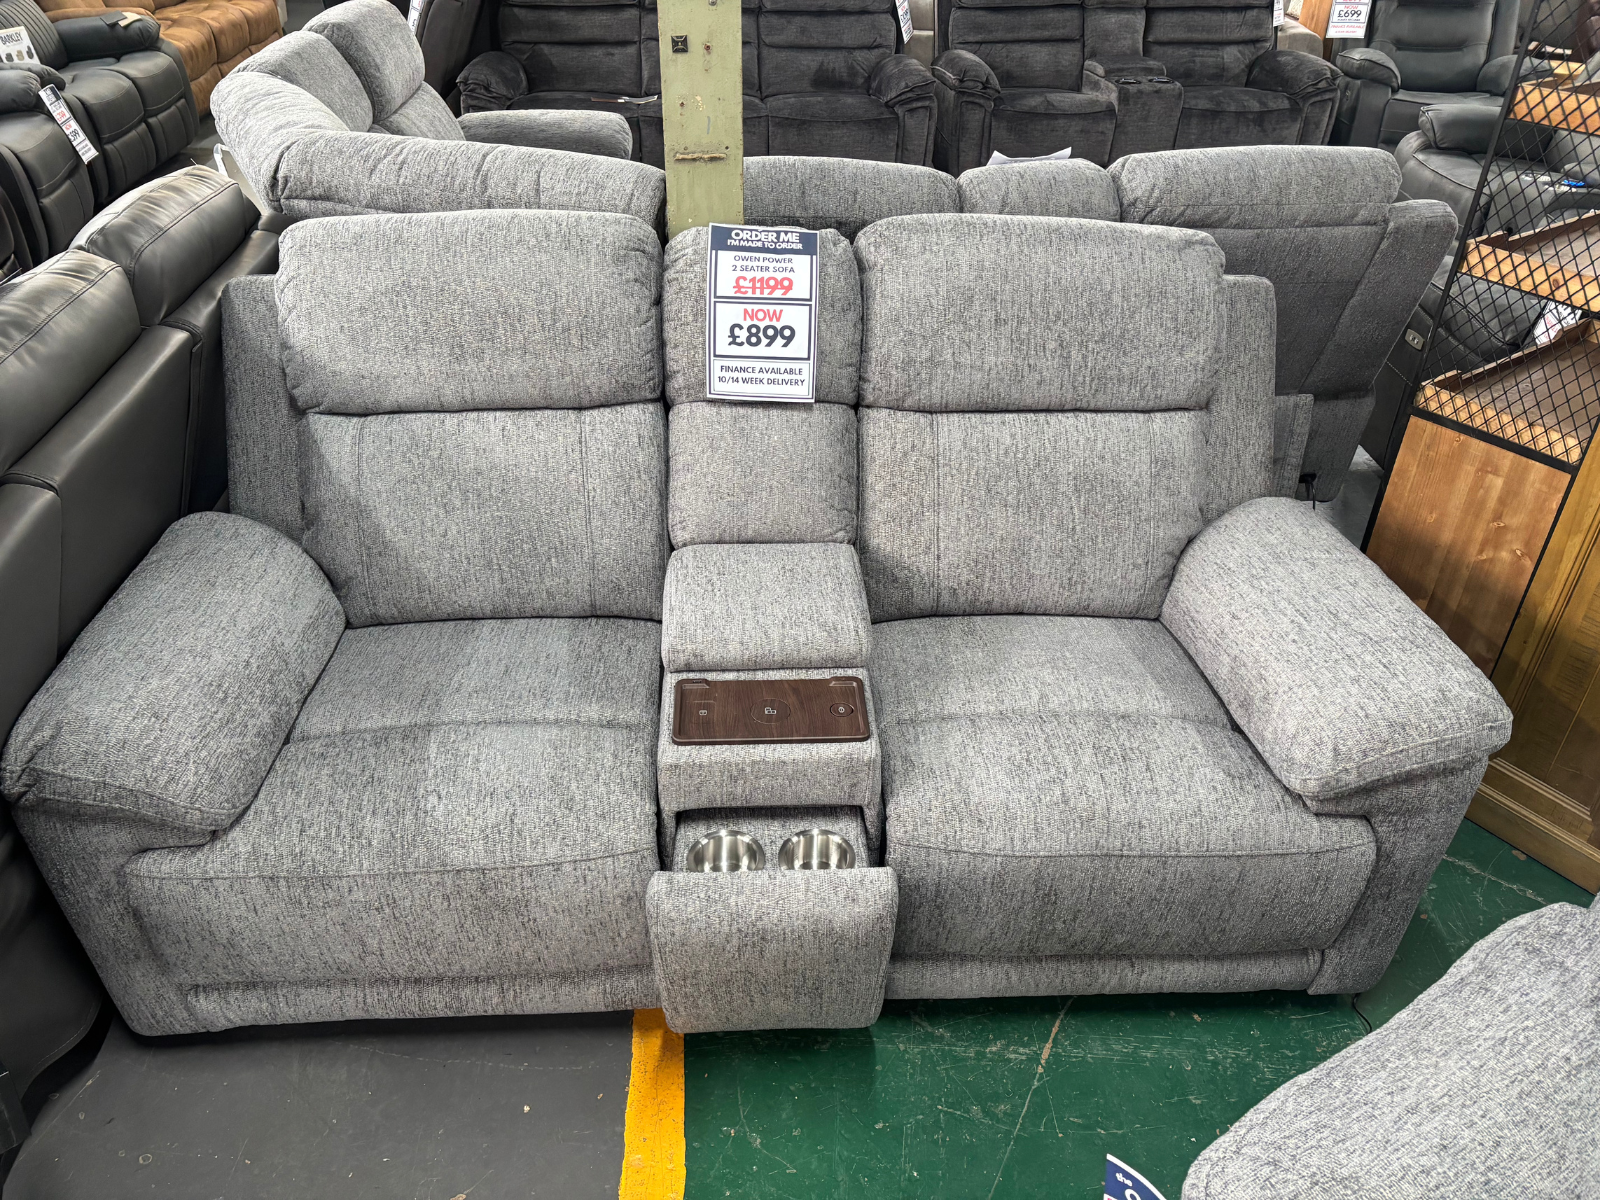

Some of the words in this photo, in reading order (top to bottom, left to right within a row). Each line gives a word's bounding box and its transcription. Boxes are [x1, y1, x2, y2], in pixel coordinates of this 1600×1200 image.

[1337, 9, 1362, 18] £699
[731, 230, 777, 242] ORDER
[780, 232, 800, 243] ME
[762, 256, 793, 264] POWER
[732, 264, 738, 272] 2
[740, 265, 770, 273] SEATER
[733, 275, 794, 296] £1199
[743, 308, 783, 322] NOW
[727, 323, 796, 348] £899
[720, 365, 756, 374] FINANCE
[758, 366, 803, 375] AVAILABLE
[717, 376, 739, 384] 10/14
[741, 376, 765, 385] WEEK
[766, 378, 806, 386] DELIVERY
[1115, 1172, 1133, 1187] the
